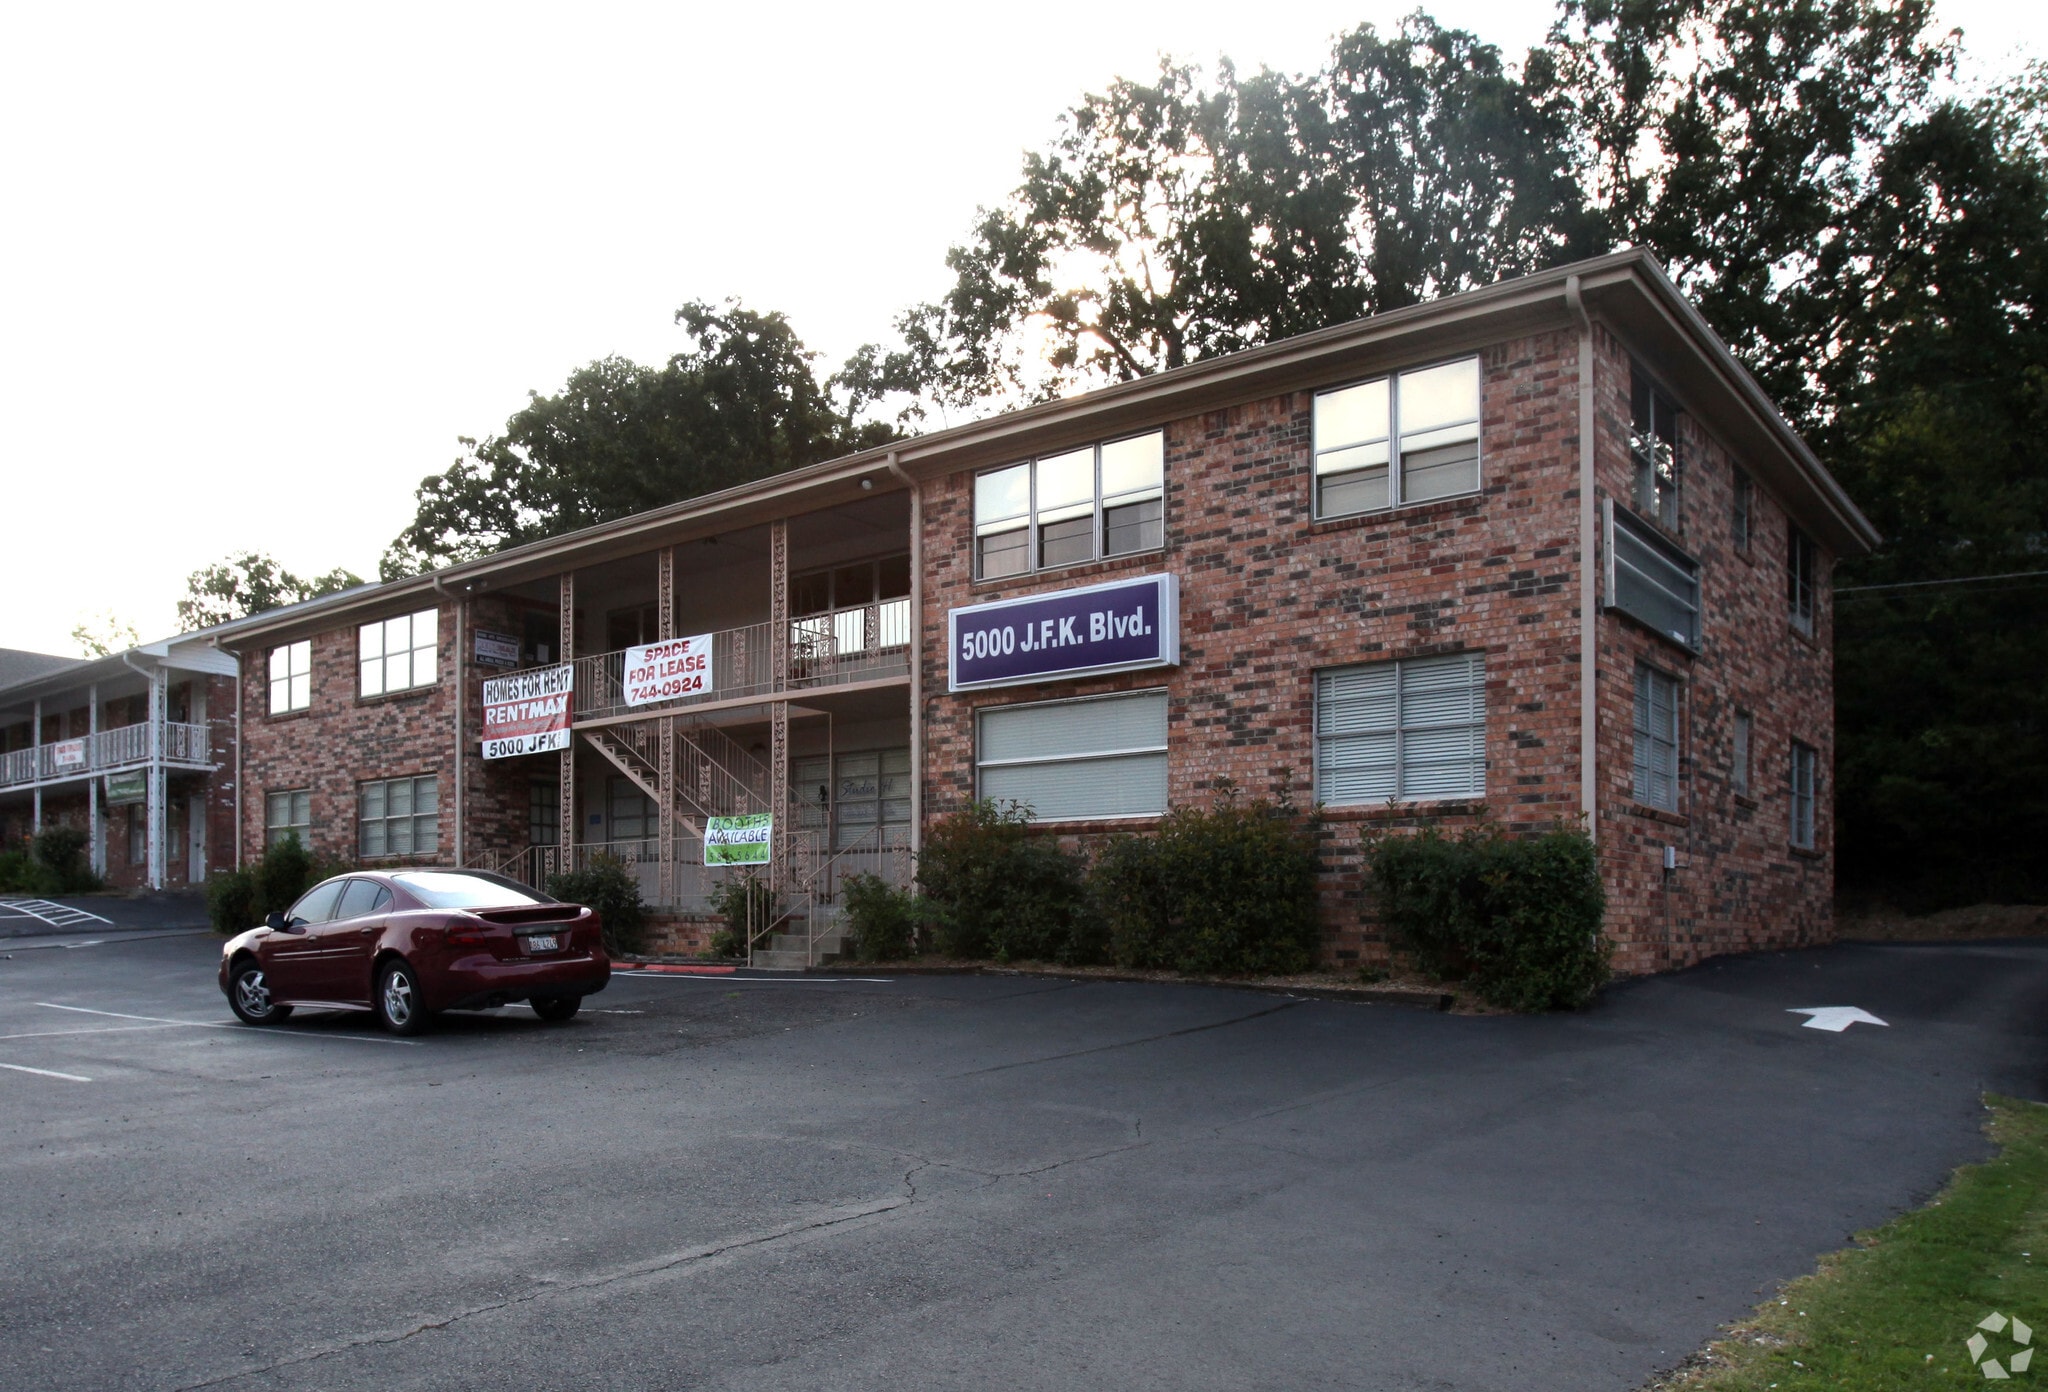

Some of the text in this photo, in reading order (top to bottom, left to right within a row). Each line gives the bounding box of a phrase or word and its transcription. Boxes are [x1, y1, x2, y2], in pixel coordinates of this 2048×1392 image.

[962, 606, 1152, 661] 5000 J.F.K. Blvd.
[644, 640, 690, 662] SPACE
[629, 654, 706, 684] FOR LEASE
[486, 668, 570, 704] HOMES FOR RENT
[631, 675, 703, 702] 744-0924
[486, 695, 568, 725] RENTMAX
[489, 739, 523, 757] 5000
[529, 734, 557, 752] JFK
[712, 814, 769, 830] BOOTHS
[708, 828, 767, 844] AVAILABLE
